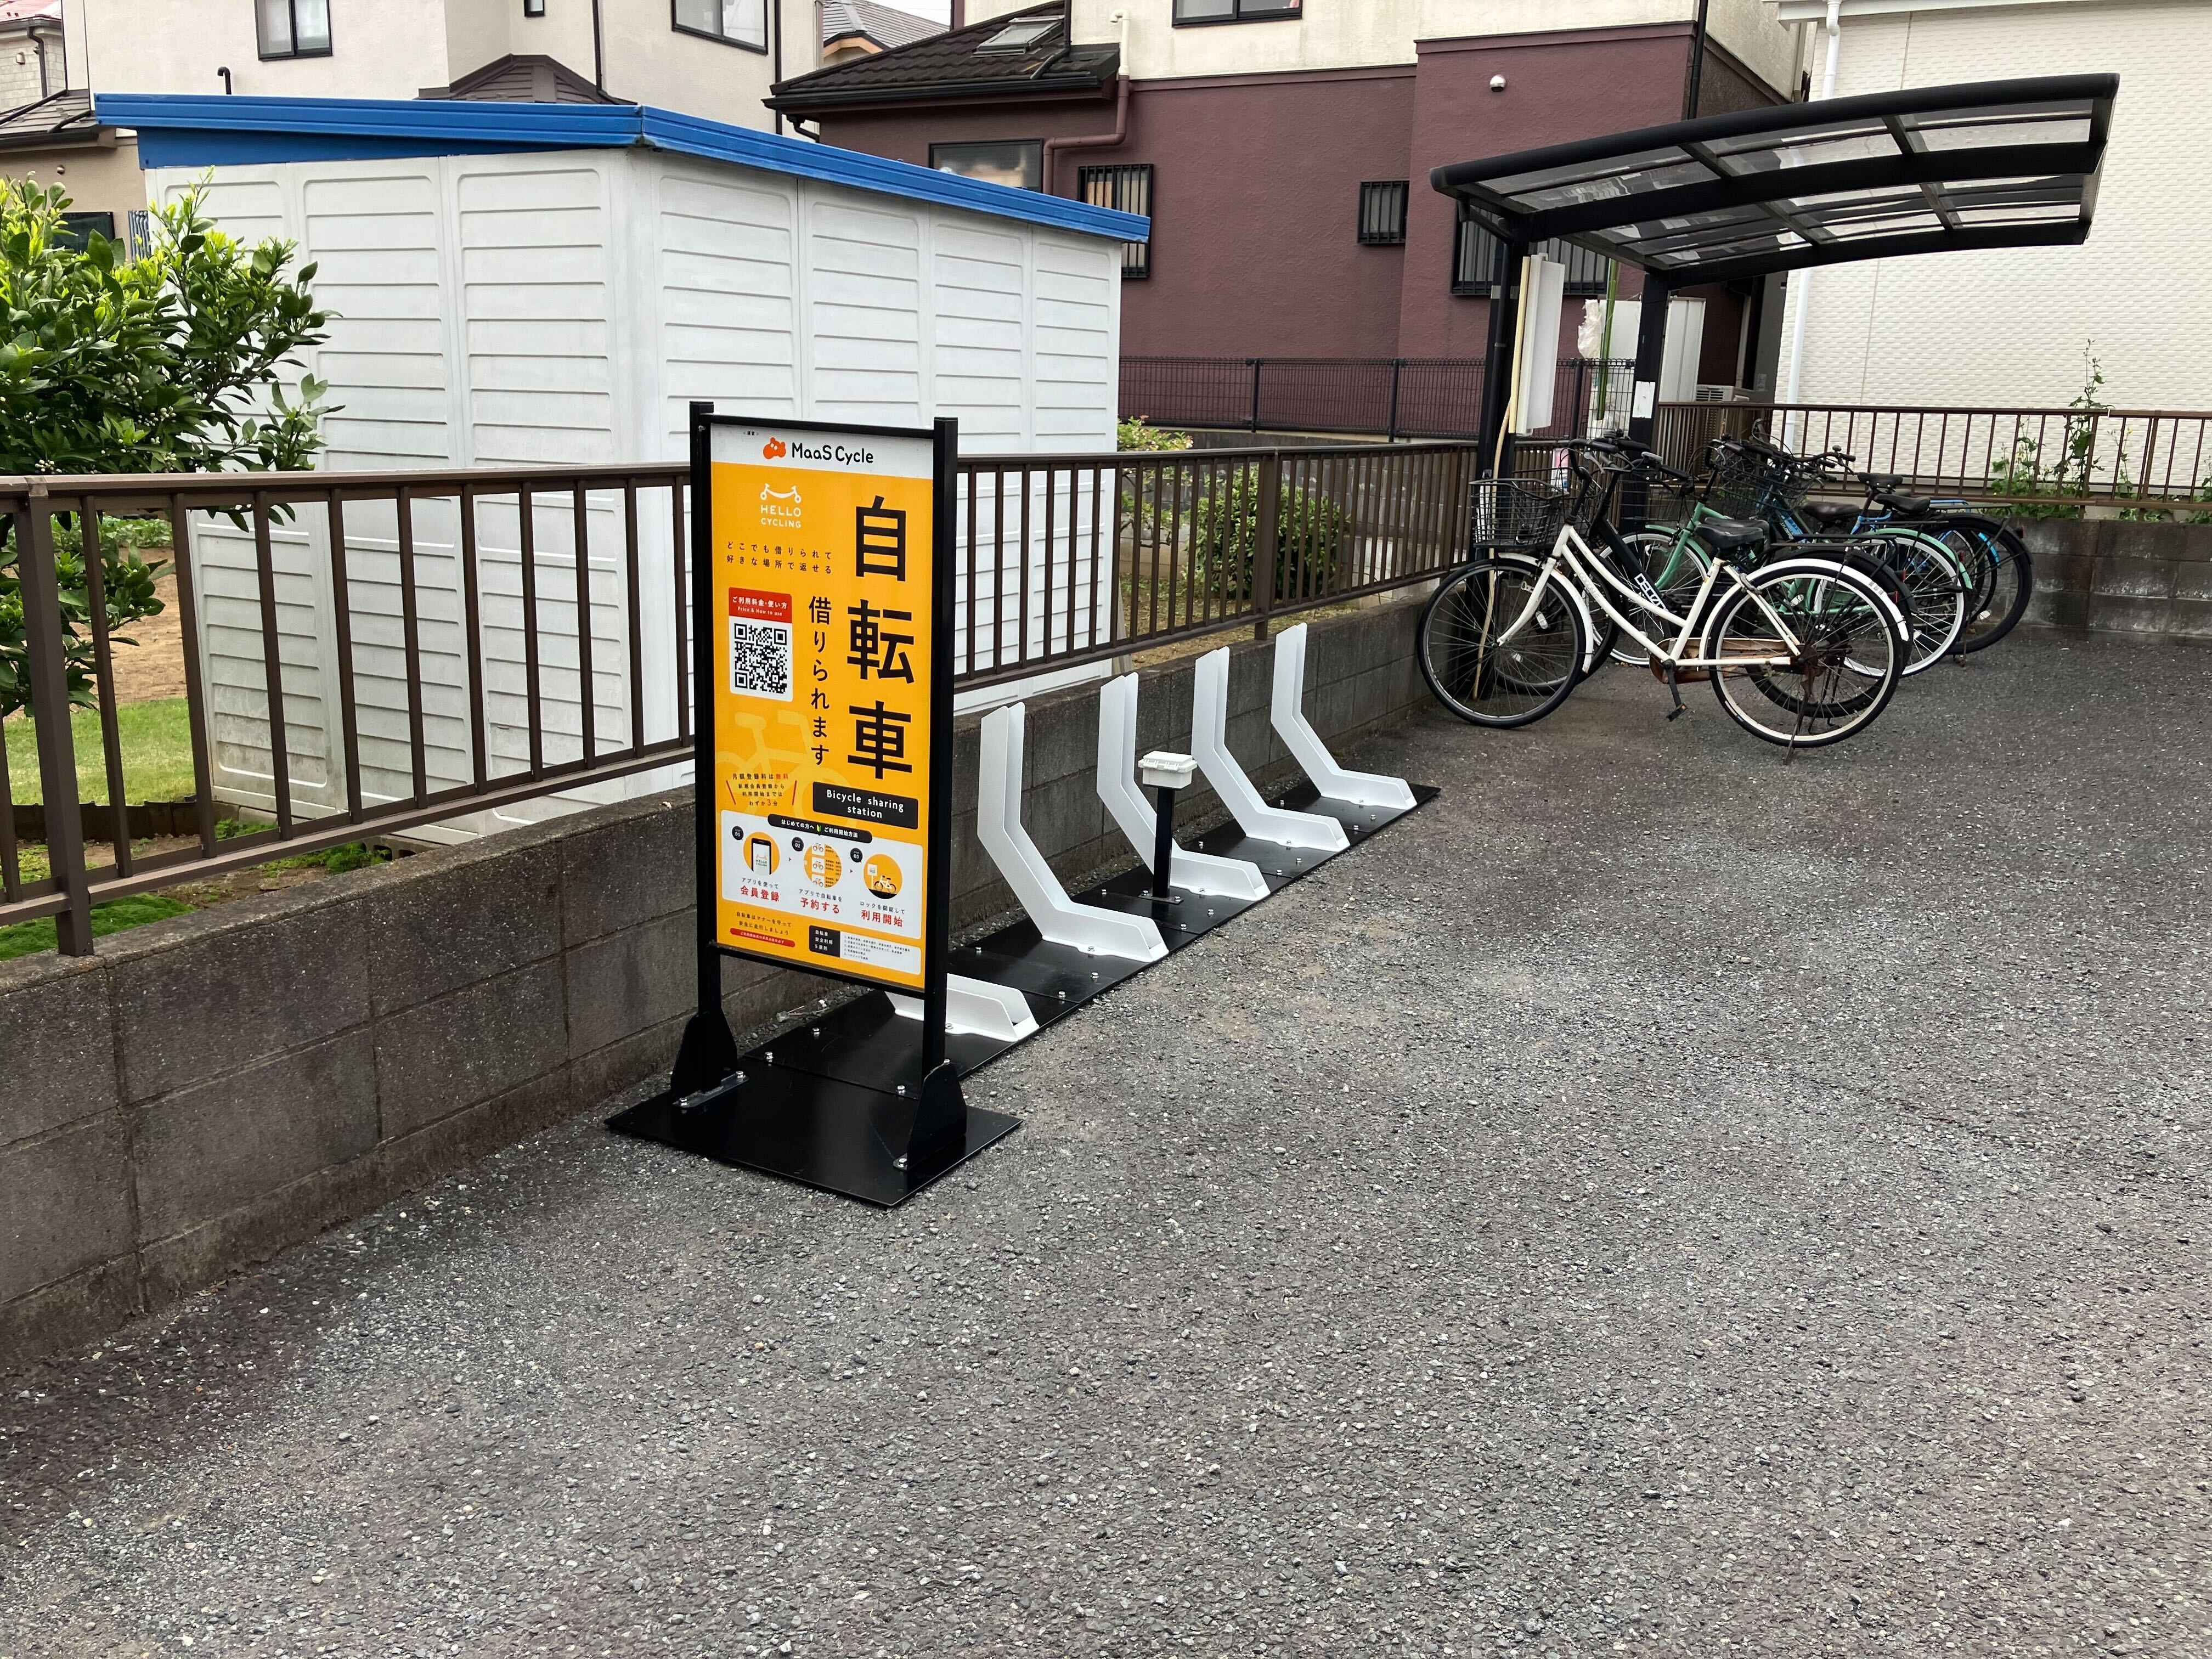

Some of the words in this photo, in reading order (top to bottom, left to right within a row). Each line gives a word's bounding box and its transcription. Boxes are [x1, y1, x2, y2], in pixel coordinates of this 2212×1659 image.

[792, 442, 832, 460] MaaS
[836, 445, 873, 465] Cycle
[760, 504, 801, 517] HELLO
[761, 517, 801, 528] CYCLING
[727, 541, 832, 560] どこでも借りられて
[727, 555, 832, 574] 好きな場所で返せる
[847, 495, 915, 780] 自転車
[808, 595, 832, 766] 借りられます
[827, 789, 862, 803] Bicycle
[867, 797, 904, 812] sharing
[847, 806, 883, 819] station
[741, 885, 780, 902] 会員登録
[800, 897, 839, 913] 予約する
[861, 909, 903, 927] 利用開始
